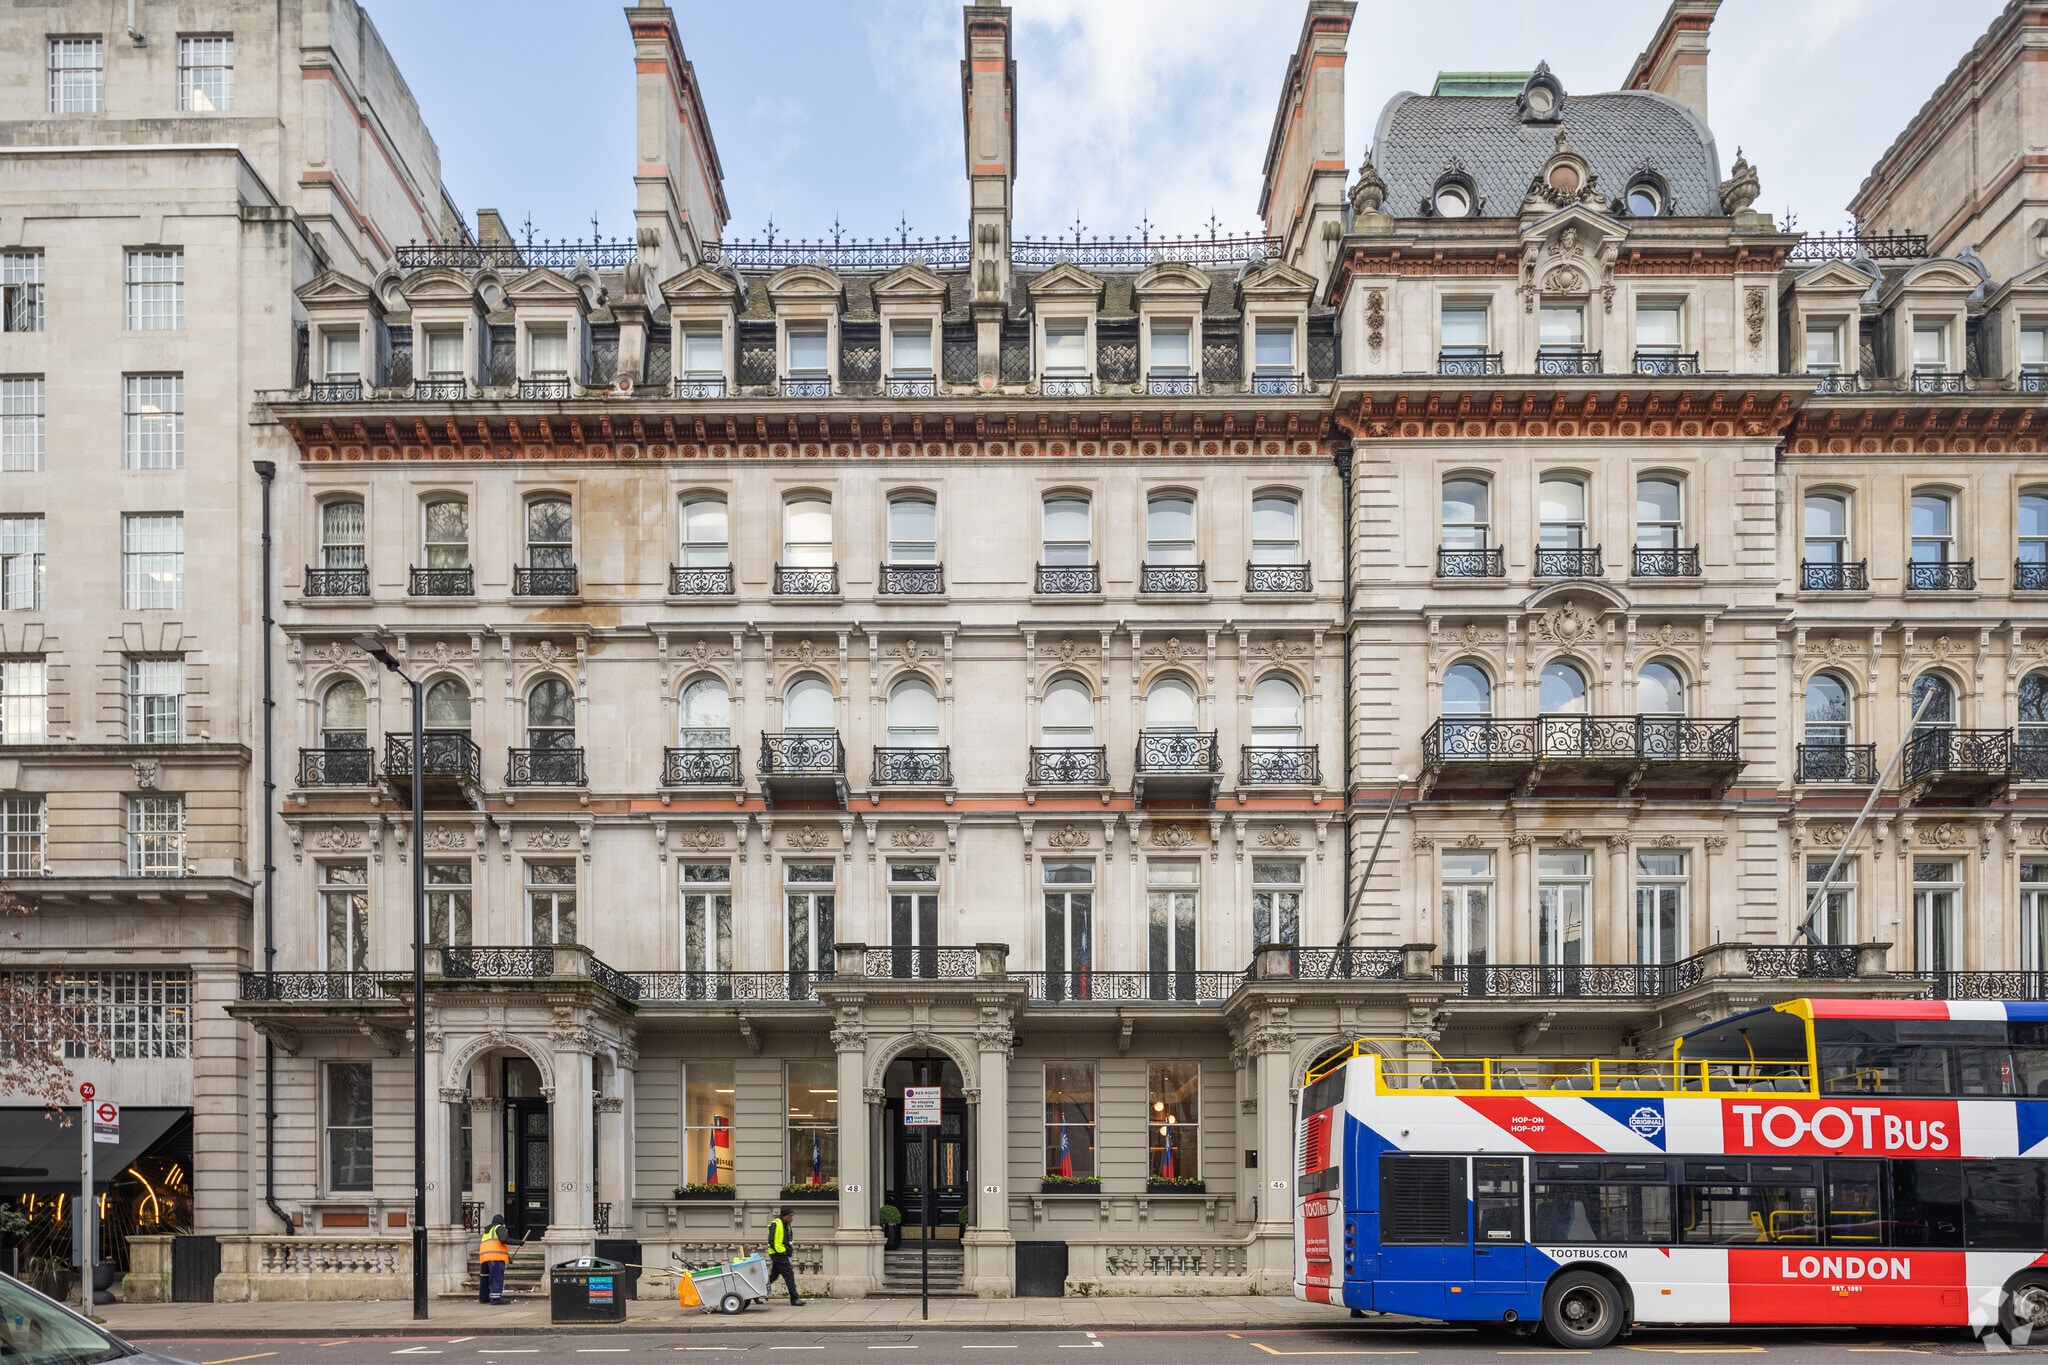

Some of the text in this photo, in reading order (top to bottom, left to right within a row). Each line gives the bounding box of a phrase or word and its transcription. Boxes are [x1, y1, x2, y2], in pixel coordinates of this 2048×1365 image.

[83, 1085, 94, 1095] Z6
[1512, 1116, 1544, 1124] HOP-ON
[561, 1183, 573, 1191] 50
[1273, 1181, 1285, 1189] 46
[1550, 1249, 1628, 1259] TOOTBUS.COM
[1782, 1256, 1911, 1280] LONDON
